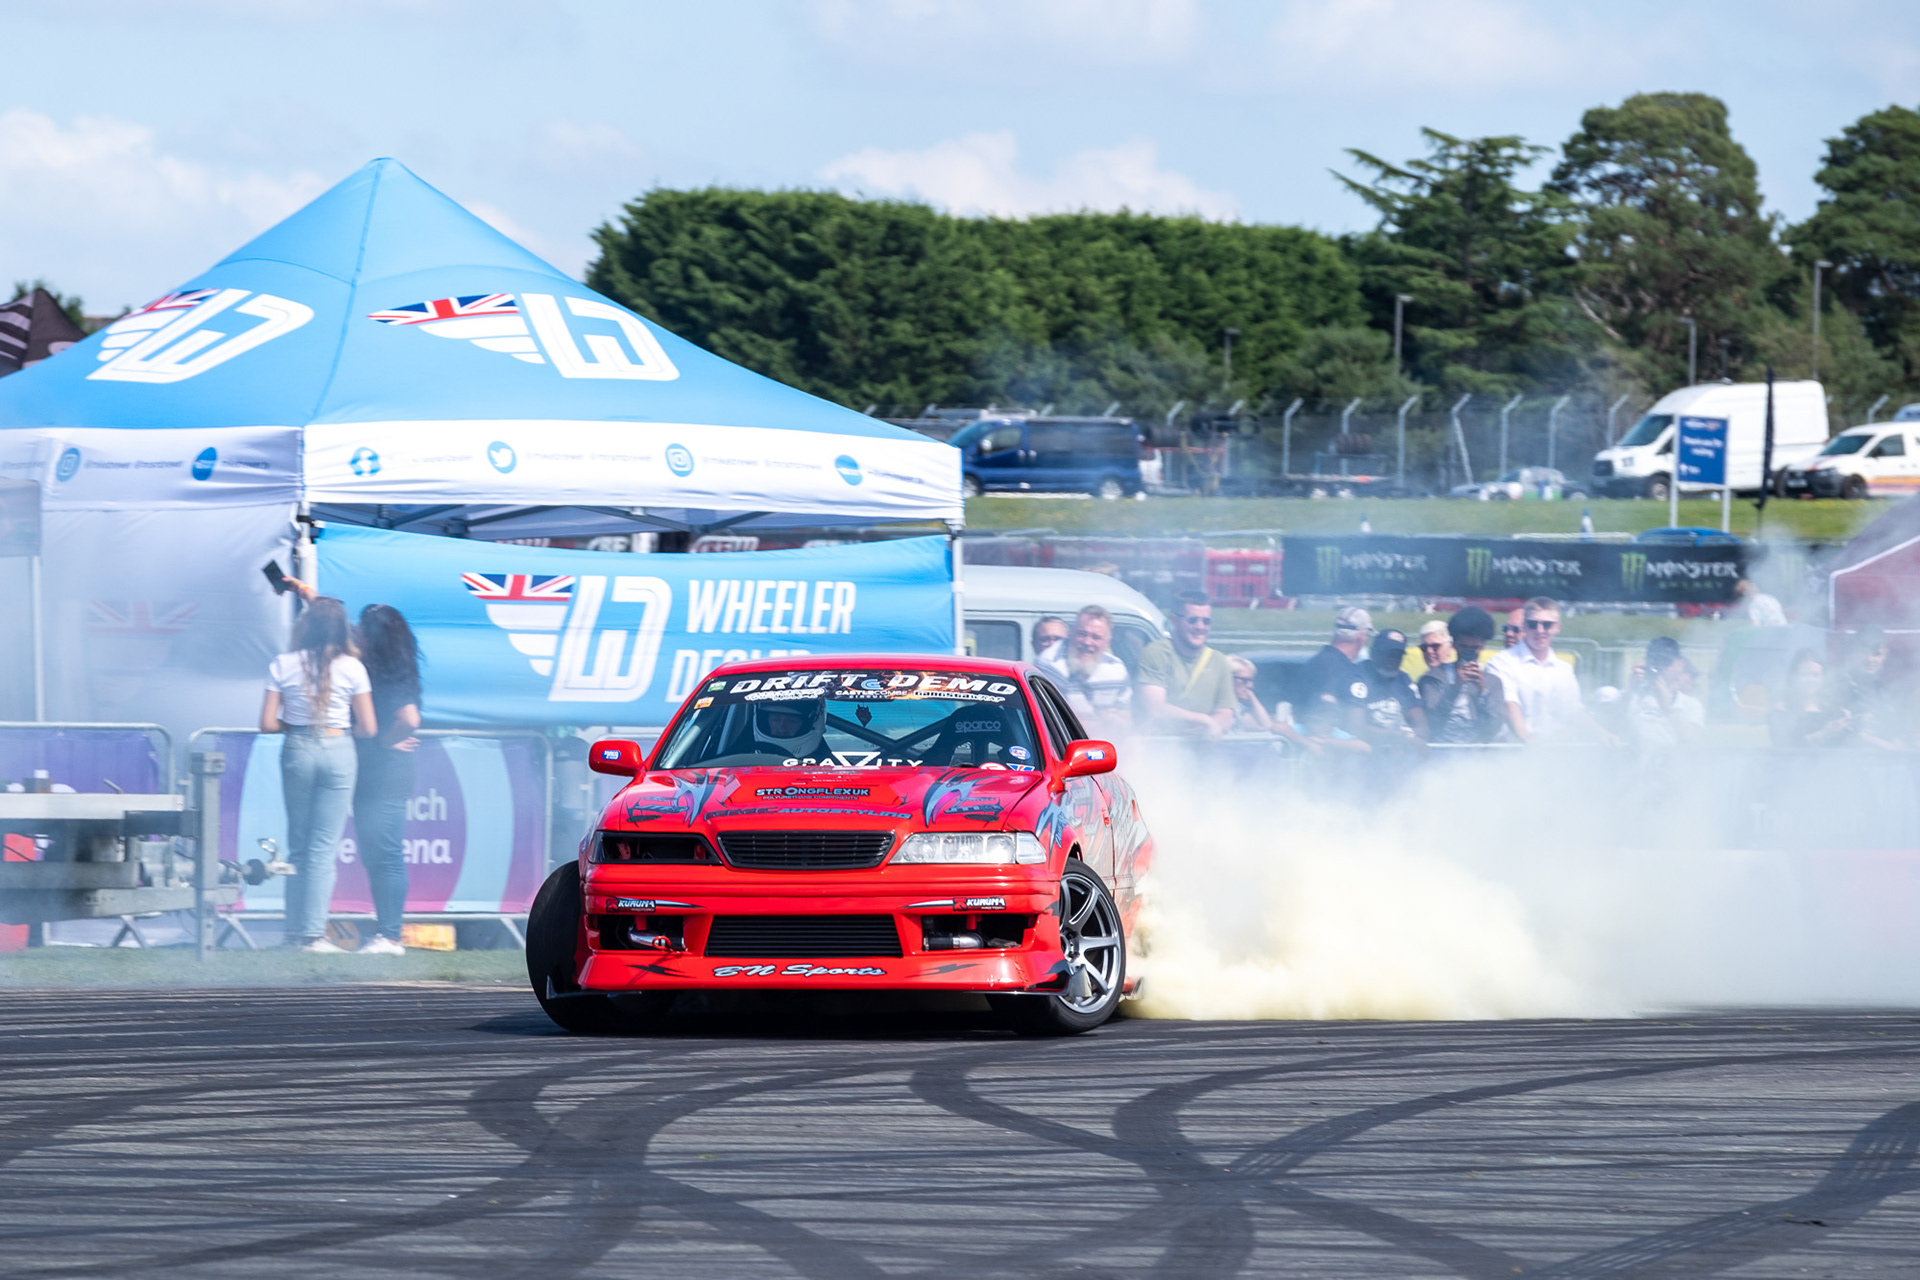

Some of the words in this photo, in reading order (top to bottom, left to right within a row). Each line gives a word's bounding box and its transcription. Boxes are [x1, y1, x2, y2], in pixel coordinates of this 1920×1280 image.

[1646, 560, 1740, 579] MONSTER
[686, 580, 857, 634] WHEELER
[730, 674, 867, 694] DRIFT
[888, 674, 1017, 695] DEMO
[713, 965, 776, 977] BN
[781, 964, 887, 977] Sports
